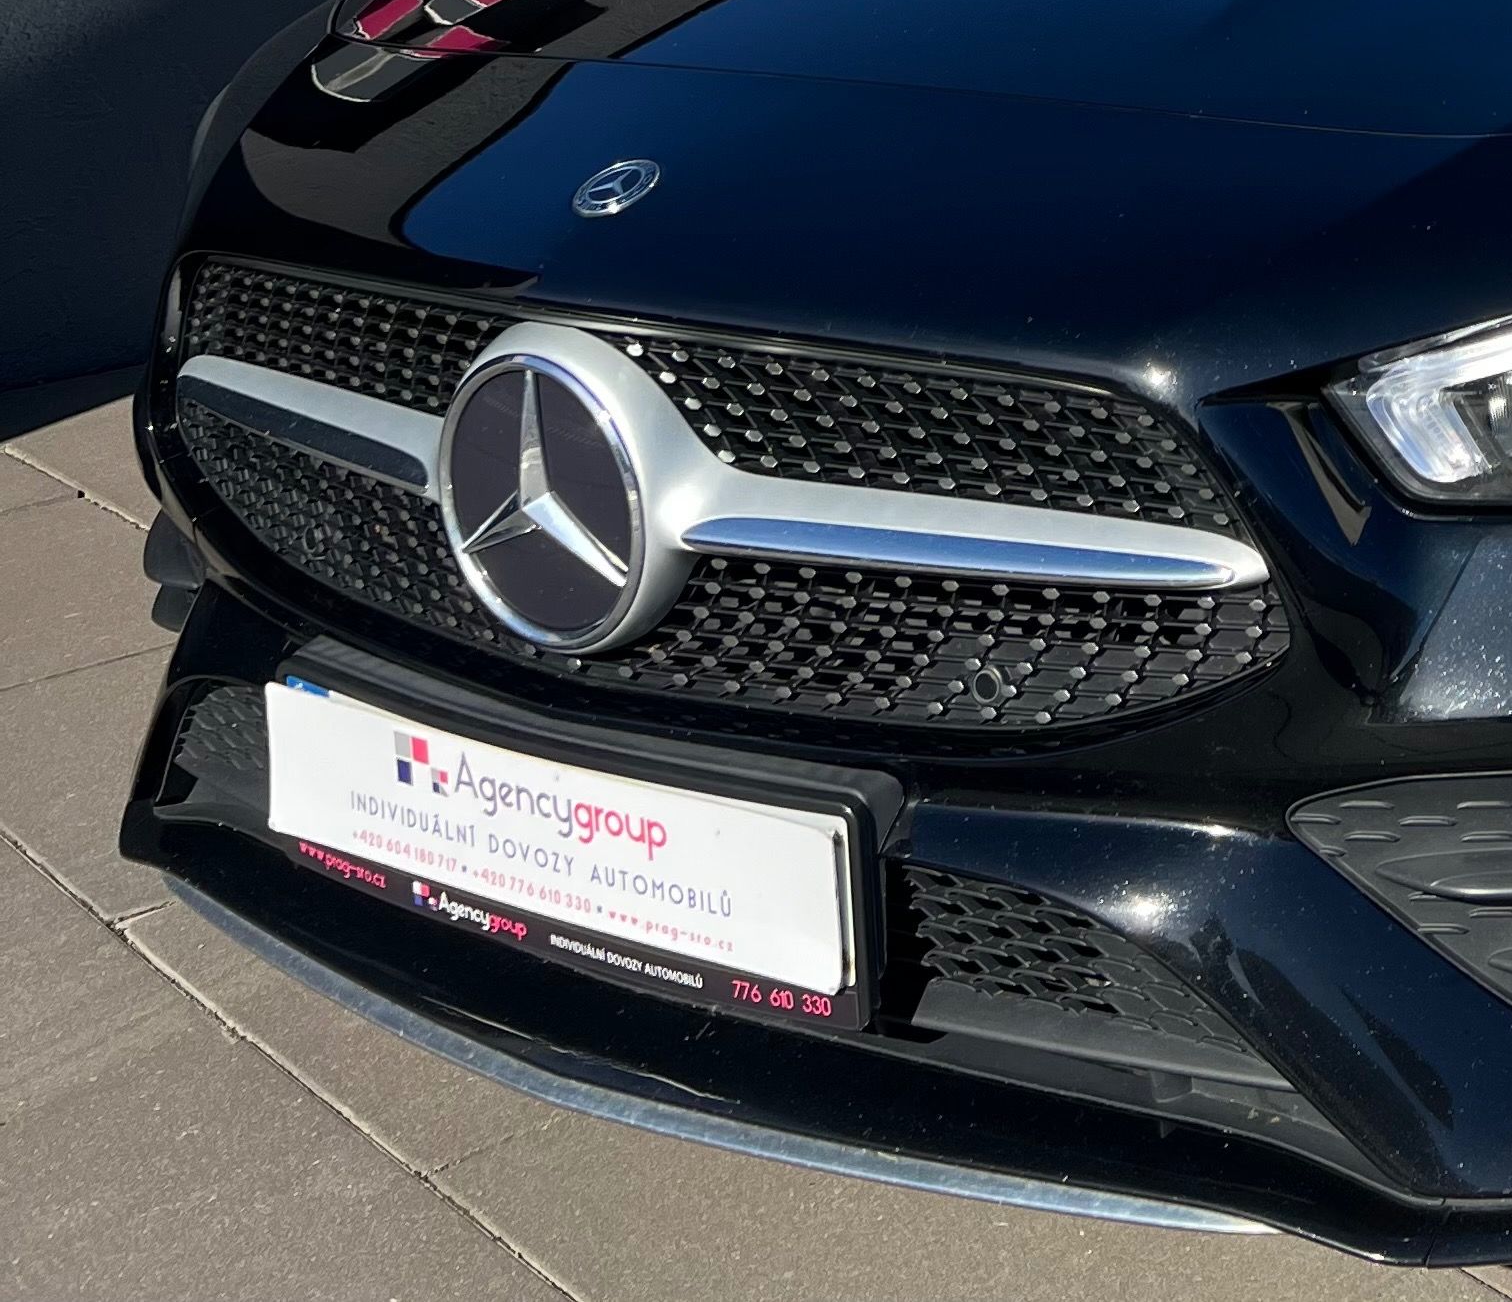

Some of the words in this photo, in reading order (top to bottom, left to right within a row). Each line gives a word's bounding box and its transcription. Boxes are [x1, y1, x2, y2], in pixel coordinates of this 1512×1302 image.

[454, 751, 668, 862] Agencygroup
[350, 790, 476, 848] INDIVIDUÁLNÍ
[488, 833, 575, 877] DOVOZY
[590, 863, 732, 918] AUTOMOBILŮ
[352, 828, 383, 850] +420
[386, 838, 411, 859] 604
[414, 846, 434, 866] 180
[472, 867, 506, 888] +420
[509, 875, 535, 898] 776
[539, 883, 561, 905] 610
[565, 892, 592, 914] 330
[438, 890, 528, 941] Agencygroup
[606, 951, 643, 972] DOVOZY
[643, 962, 704, 989] AUTOMOBILŮ
[731, 979, 762, 1003] 776
[769, 987, 794, 1010] 610
[802, 993, 832, 1017] 330
